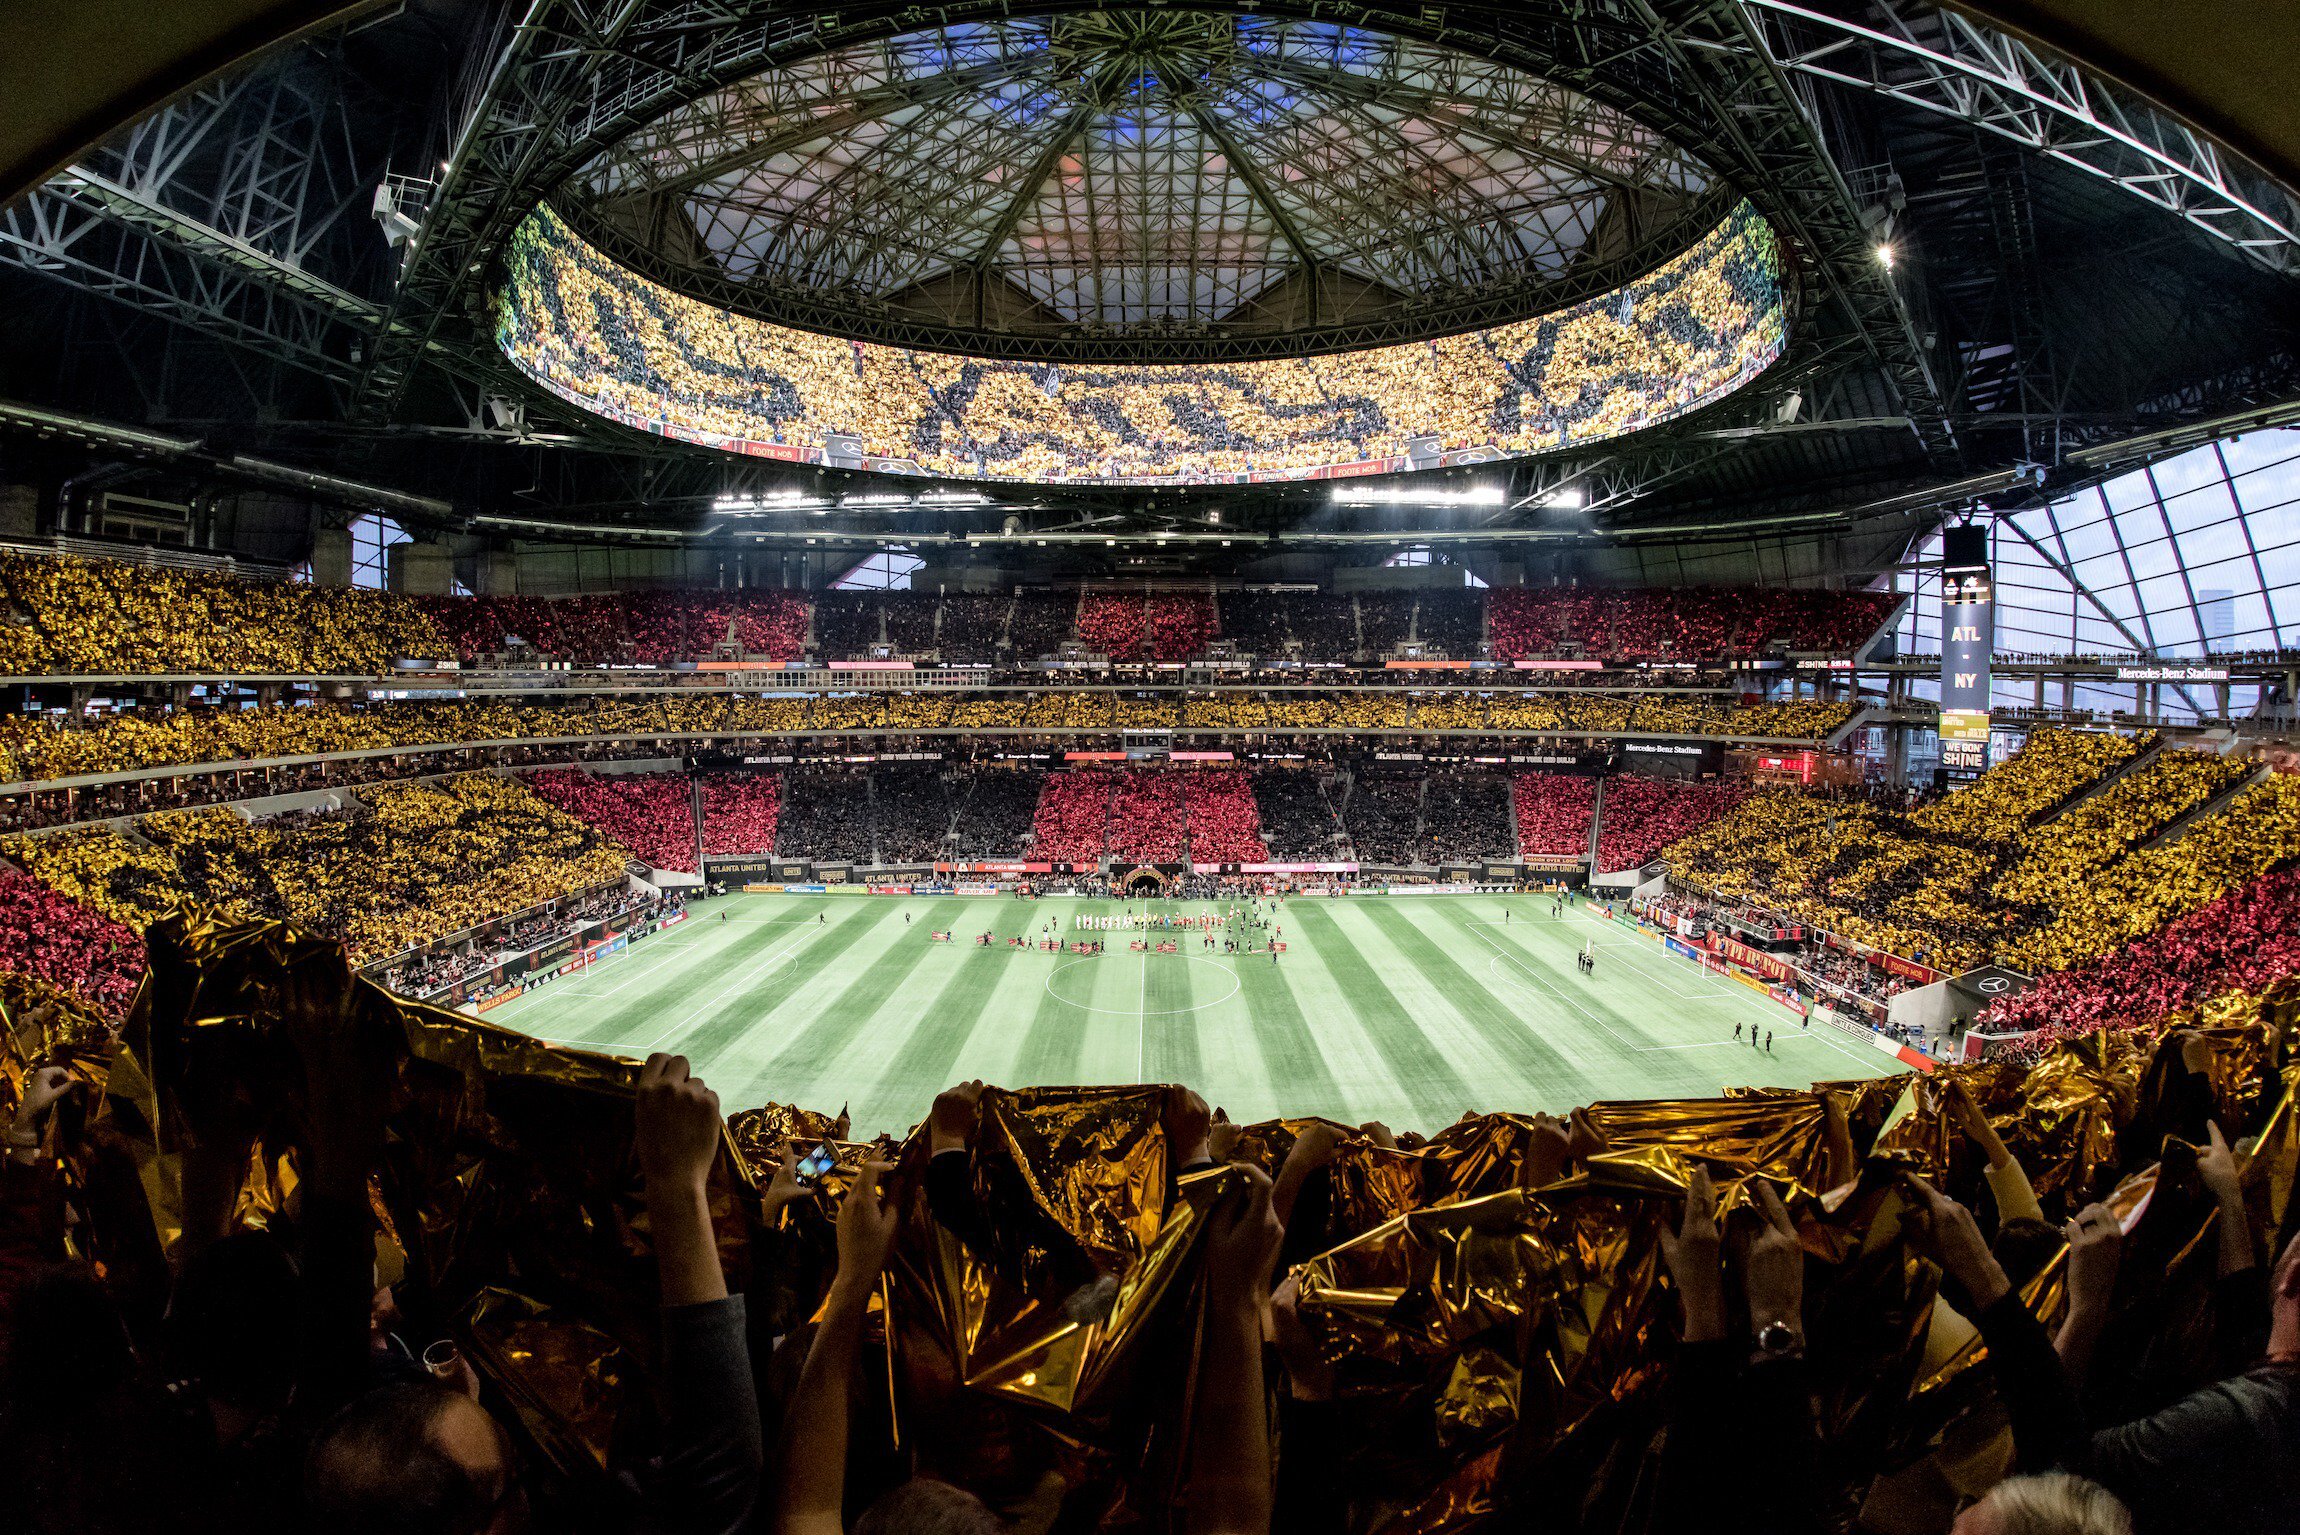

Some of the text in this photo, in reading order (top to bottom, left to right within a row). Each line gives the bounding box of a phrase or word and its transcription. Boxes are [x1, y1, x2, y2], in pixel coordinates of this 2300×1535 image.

[1951, 626, 1981, 642] ATL
[1805, 660, 1828, 669] SHINE
[1954, 672, 1977, 688] NY
[2117, 667, 2228, 680] Mercedes-Benz Stadium
[1625, 743, 1702, 755] Mercedes-Benz Stadium
[1945, 742, 1984, 753] WE GON'
[1942, 752, 1983, 770] SHINE
[709, 863, 767, 873] ATLANTA UNITED
[1559, 865, 1586, 873] UNITED
[864, 873, 922, 883] ATLANTA UNITED
[1890, 960, 1923, 979] FOOTIE MOB
[478, 987, 523, 1012] WELLS FARGO
[1832, 1016, 1847, 1029] UNITE
[1851, 1025, 1876, 1042] CONQUER
